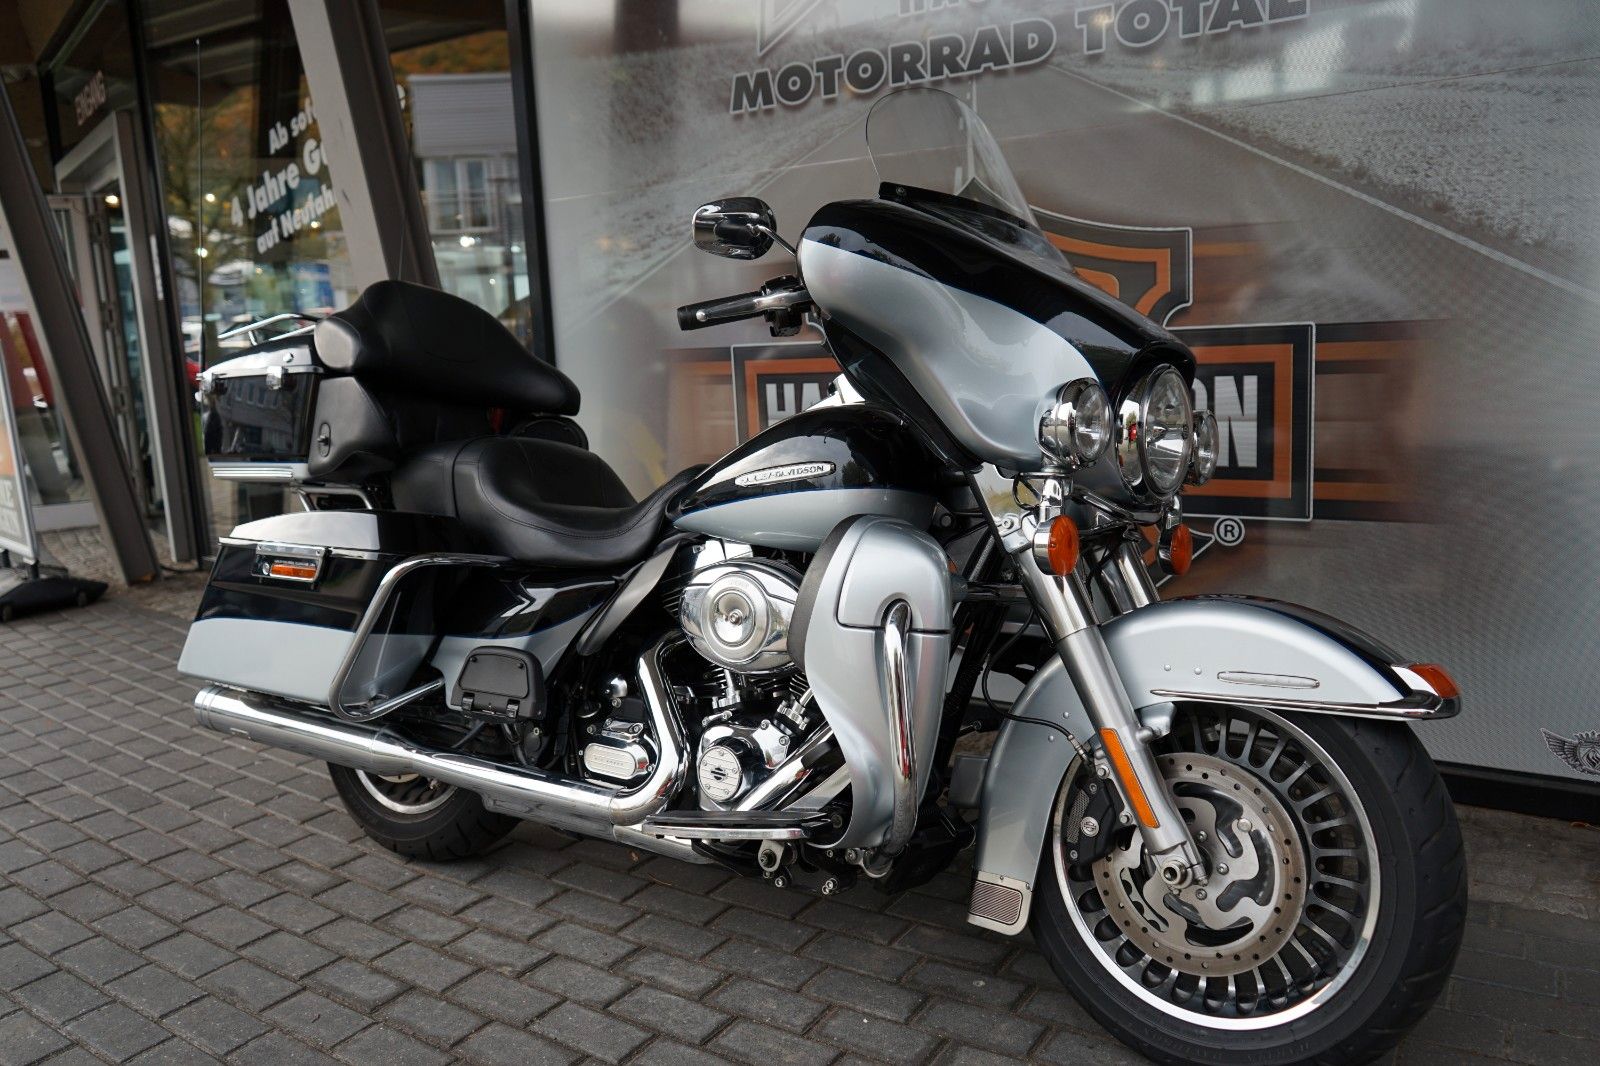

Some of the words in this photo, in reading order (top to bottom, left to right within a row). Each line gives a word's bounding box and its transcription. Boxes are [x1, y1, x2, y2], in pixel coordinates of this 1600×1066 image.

[730, 18, 1056, 114] MOTORRAD
[269, 121, 289, 155] Ab
[290, 97, 316, 137] sof
[230, 196, 243, 227] 4
[246, 162, 300, 220] Jahre
[257, 217, 280, 255] auf
